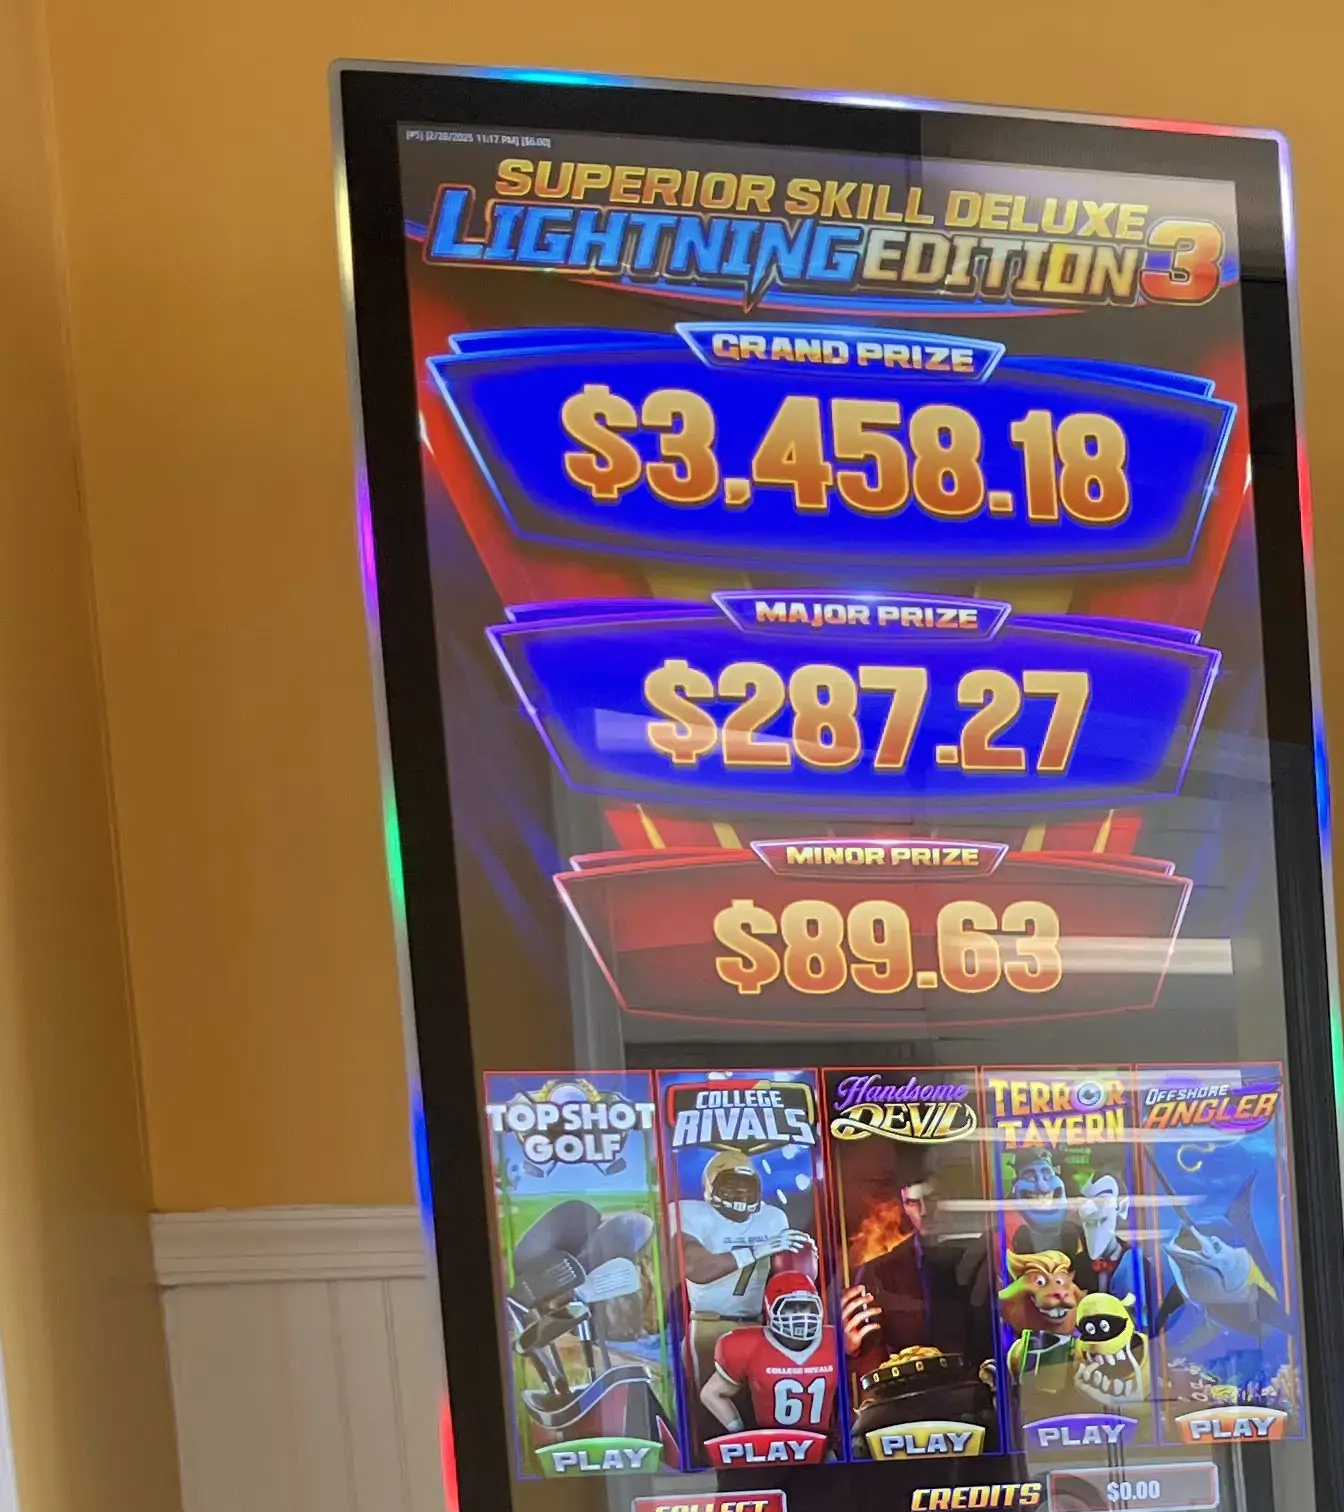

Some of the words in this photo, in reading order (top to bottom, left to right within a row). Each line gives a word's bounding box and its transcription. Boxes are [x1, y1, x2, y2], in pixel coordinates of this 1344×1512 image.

[496, 157, 774, 215] SUPERIOR
[784, 181, 934, 228] SKILL
[945, 190, 1151, 242] DELUXE
[428, 186, 864, 308] LIGHTNING
[862, 226, 1142, 307] EDITION
[1140, 216, 1228, 308] 3
[711, 332, 850, 367] GRAND
[856, 341, 976, 374] PRIZE
[559, 382, 1131, 527] $3,458.18
[754, 599, 872, 629] MAJOR
[876, 603, 980, 631] PRIZE
[642, 658, 1092, 774] $287.27
[784, 844, 885, 869] MINOR
[890, 845, 980, 869] PRIZE
[711, 898, 1063, 996] $89.63
[695, 1089, 785, 1109] COLLEGE
[836, 1074, 969, 1111] Handsome
[989, 1077, 1125, 1117] TERROR
[1143, 1091, 1279, 1131] ANGLER
[1145, 1084, 1229, 1106] OFFSHORE
[672, 1106, 816, 1149] RIVALS
[830, 1101, 978, 1144] DEVIL
[998, 1110, 1124, 1150] TAVERN
[522, 1133, 622, 1164] GOLF
[773, 1377, 827, 1427] 61
[879, 1432, 972, 1458] PLAY
[1037, 1422, 1126, 1449] PLAY
[1190, 1413, 1276, 1441] PLAY
[551, 1446, 652, 1474] PLAY
[717, 1439, 813, 1466] PLAY
[911, 1483, 1041, 1512] CREDITS
[1106, 1479, 1162, 1503] $0.00
